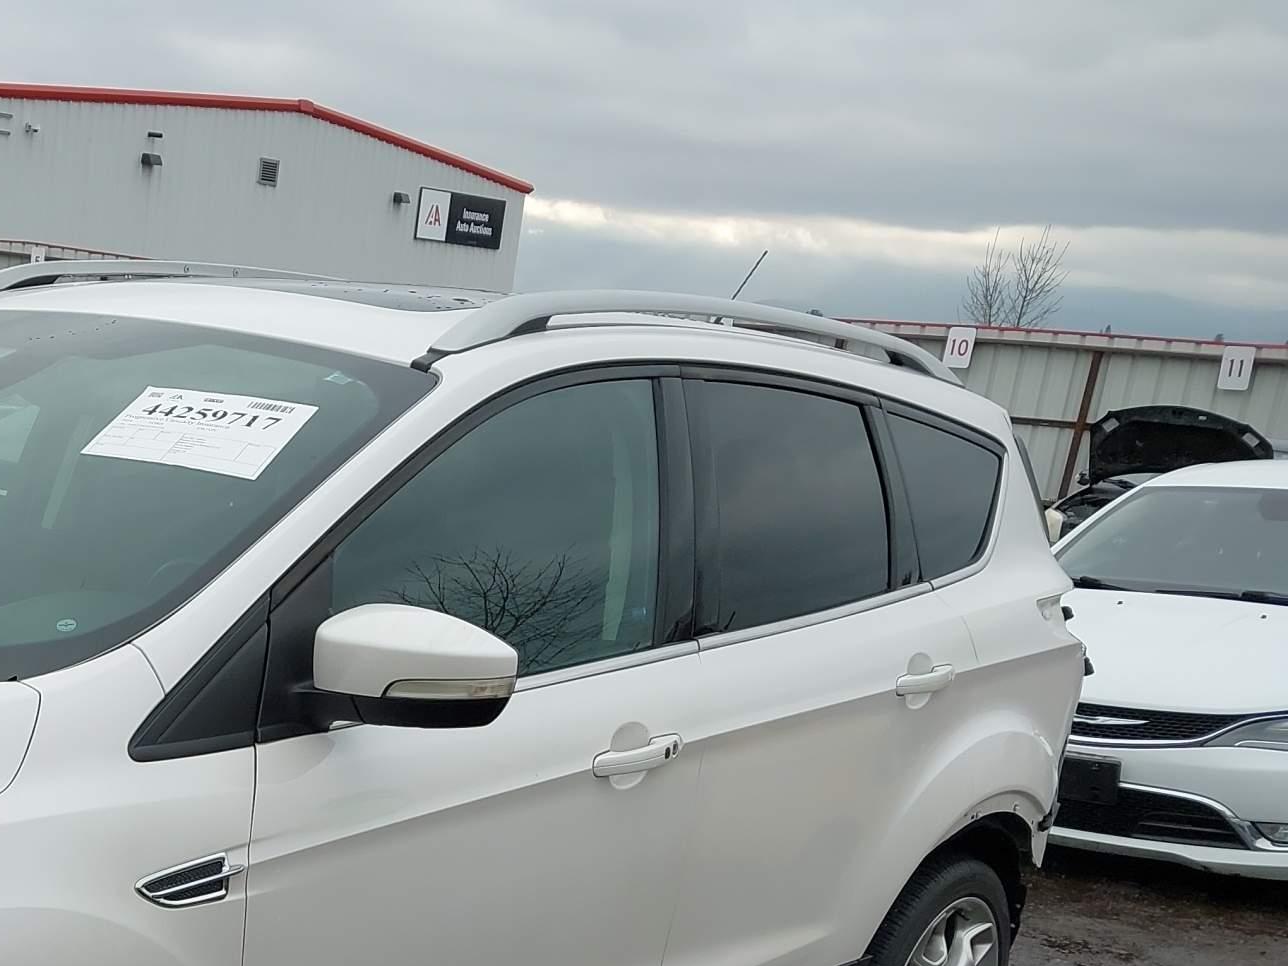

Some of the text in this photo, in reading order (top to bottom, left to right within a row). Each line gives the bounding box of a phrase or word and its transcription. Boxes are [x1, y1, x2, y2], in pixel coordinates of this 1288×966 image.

[462, 207, 490, 223] Insurance
[455, 220, 493, 236] Auto Auctions
[950, 338, 969, 357] 10
[1227, 358, 1246, 378] 11
[142, 403, 283, 431] 44259717
